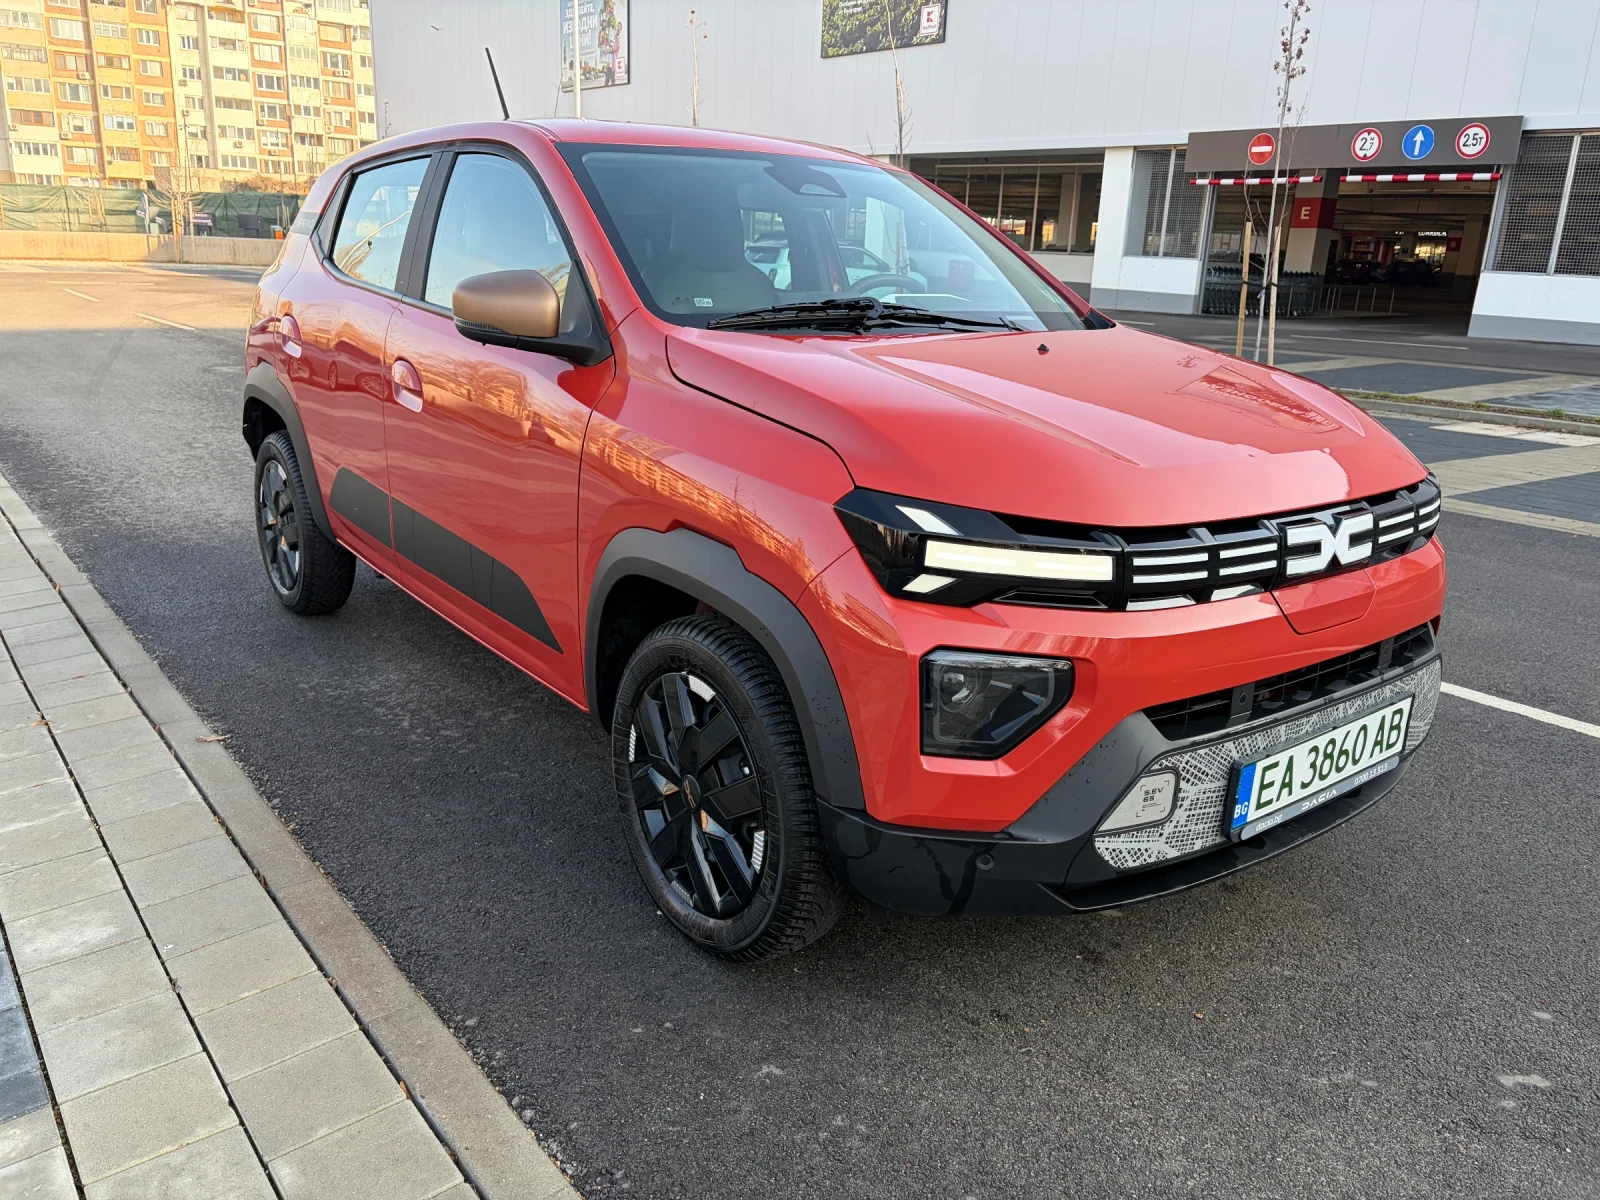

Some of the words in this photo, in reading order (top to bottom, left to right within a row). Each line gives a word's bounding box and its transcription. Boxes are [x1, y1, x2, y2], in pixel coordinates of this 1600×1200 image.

[563, 14, 598, 35] ИЗДНИ
[1300, 206, 1311, 220] E
[1255, 754, 1295, 812] EA
[1299, 723, 1369, 790] 3860
[1368, 707, 1404, 760] AB
[1234, 801, 1249, 819] BG
[1301, 788, 1338, 811] DACIA
